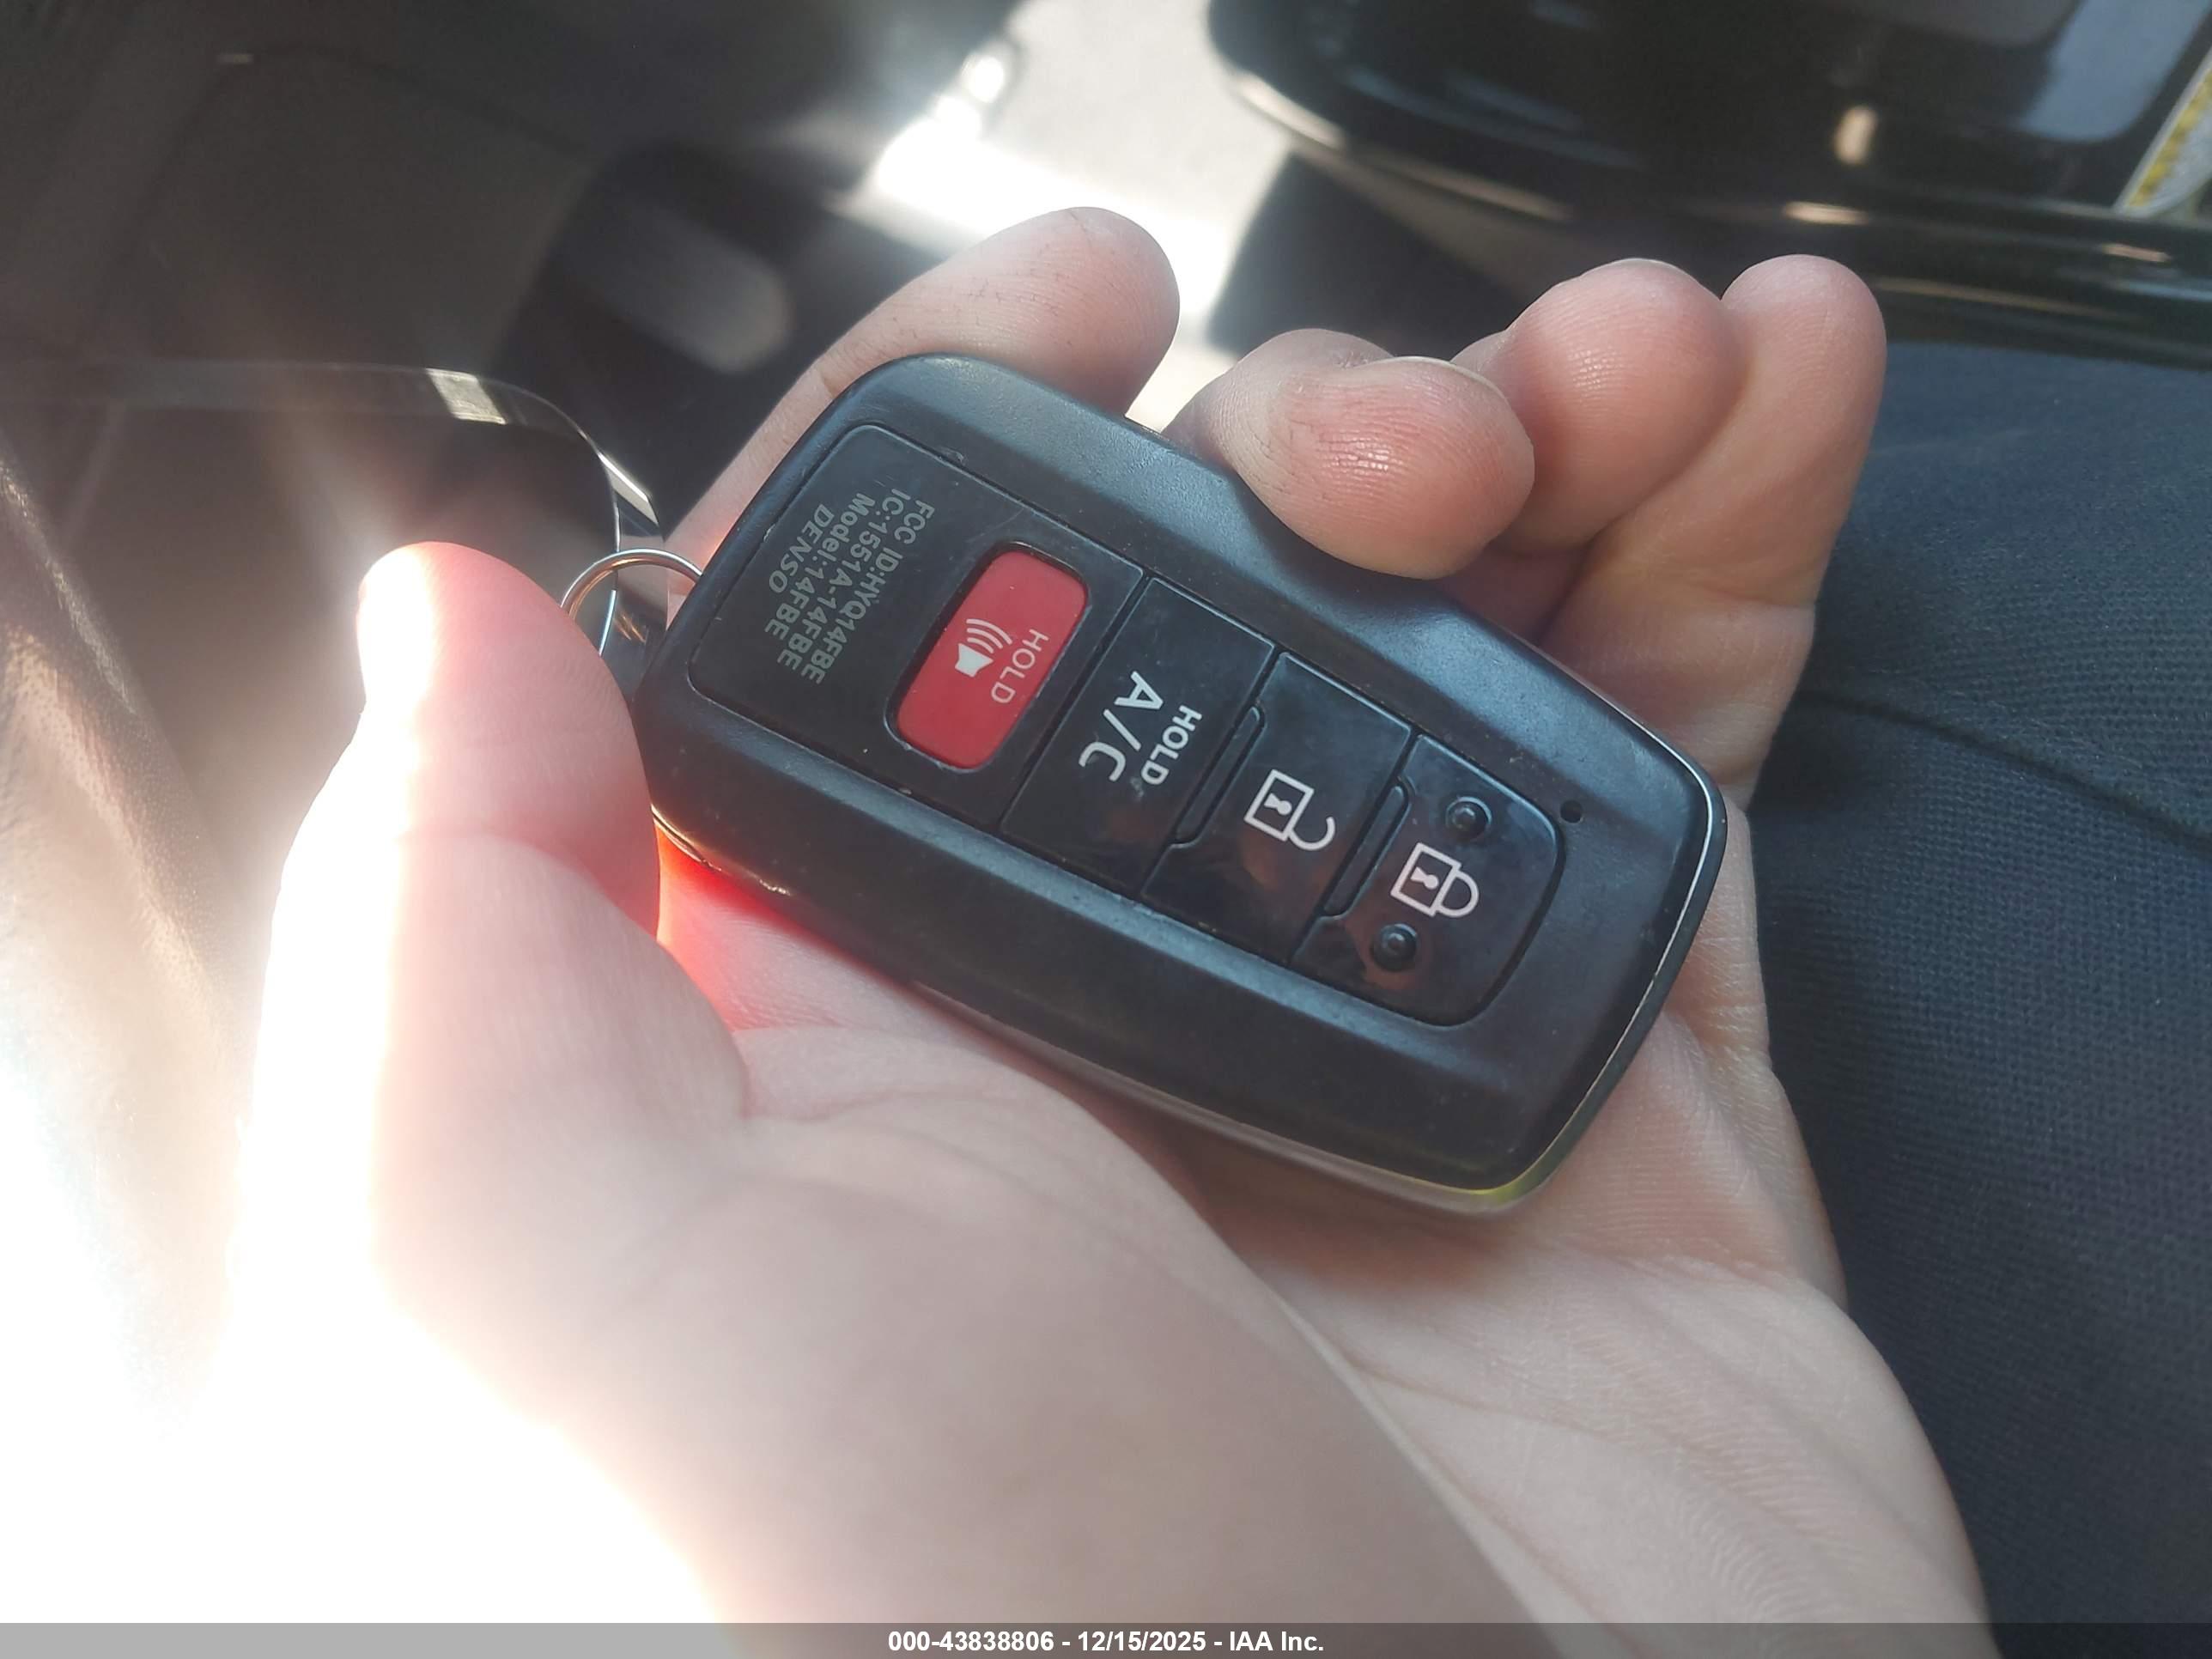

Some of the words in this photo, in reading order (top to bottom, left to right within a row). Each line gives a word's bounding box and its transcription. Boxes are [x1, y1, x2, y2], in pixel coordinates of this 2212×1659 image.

[769, 504, 835, 593] DENSO
[894, 500, 935, 544] FCC
[777, 489, 911, 670] IC:1551A-14FBE
[801, 548, 903, 684] ID:HYQ14FBE
[991, 629, 1049, 703] HOLD
[1079, 671, 1164, 782] A/C
[1141, 705, 1202, 785] HOLD
